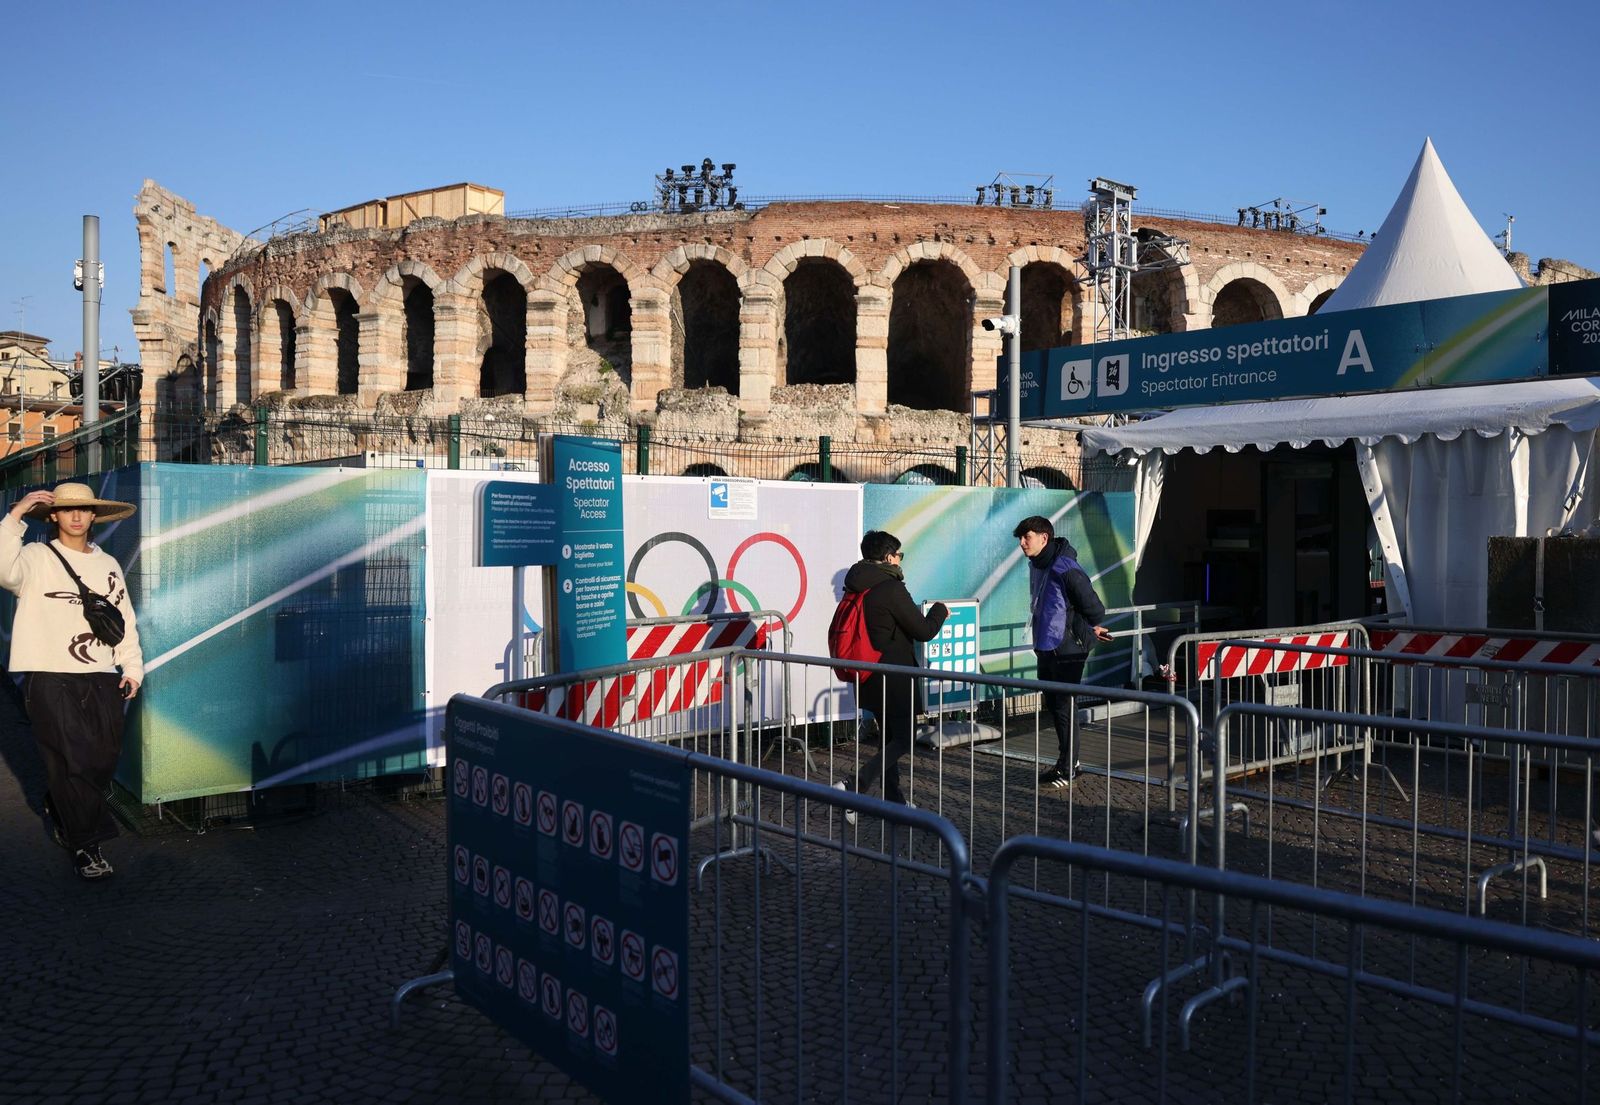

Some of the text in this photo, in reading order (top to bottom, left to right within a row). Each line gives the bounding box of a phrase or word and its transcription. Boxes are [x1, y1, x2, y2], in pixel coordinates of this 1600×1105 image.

[1141, 328, 1374, 376] Ingresso spettatori A
[1141, 369, 1277, 396] Spectator Entrance
[568, 458, 610, 472] Accesso
[566, 476, 614, 494] Spettatori
[573, 498, 610, 510] Spectator
[580, 510, 606, 519] Access
